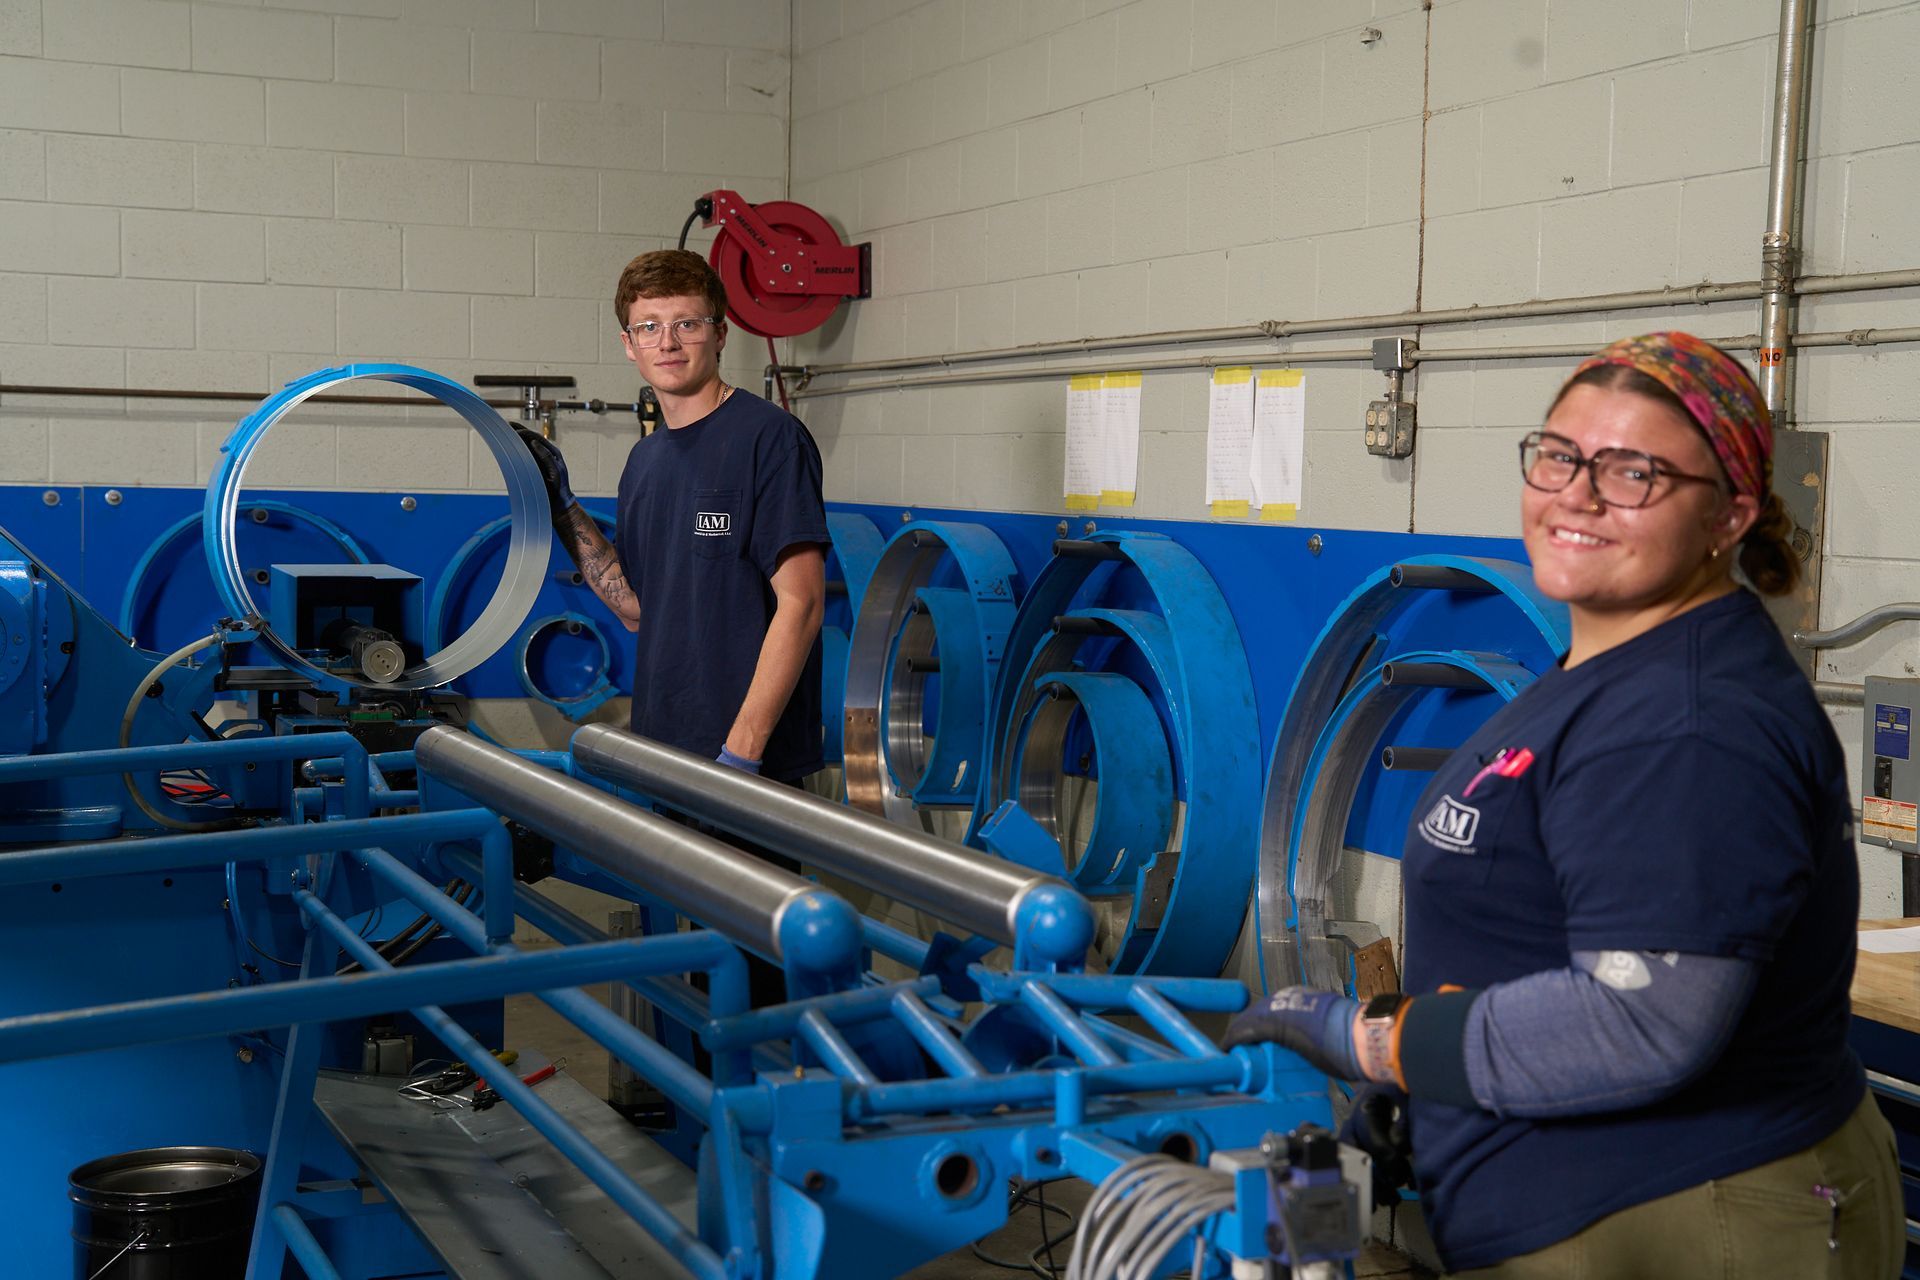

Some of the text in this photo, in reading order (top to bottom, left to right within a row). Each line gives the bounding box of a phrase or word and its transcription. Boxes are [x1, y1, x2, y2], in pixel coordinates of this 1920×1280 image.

[735, 215, 768, 248] MERLIN
[815, 266, 855, 274] MERLIN
[698, 515, 726, 529] IAM
